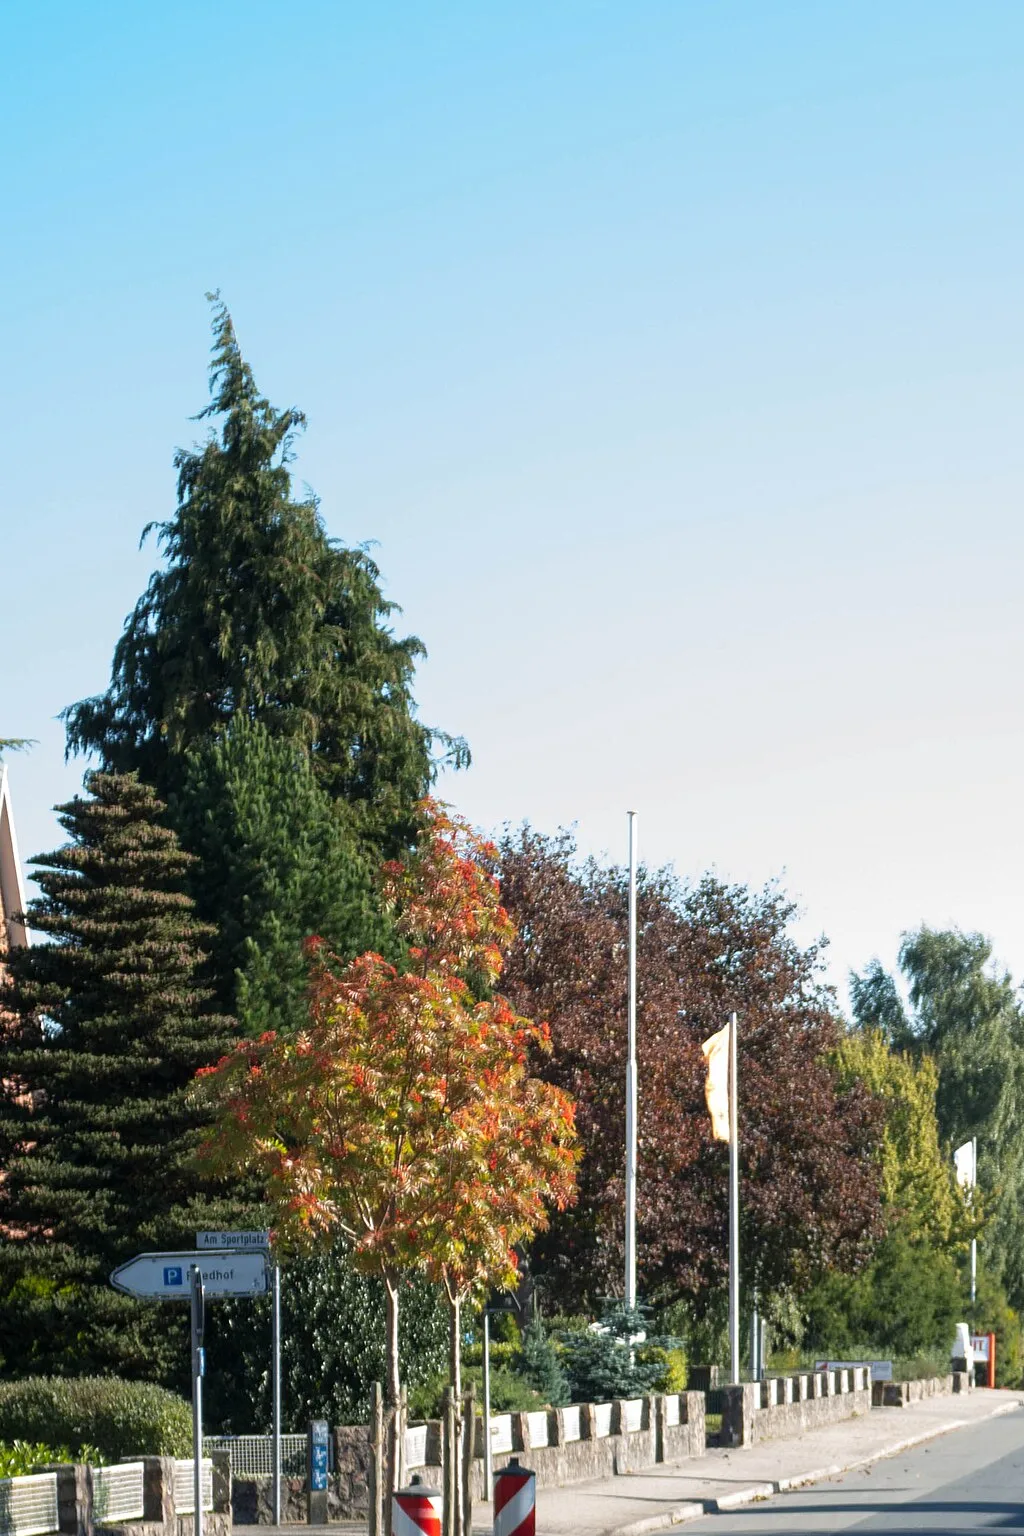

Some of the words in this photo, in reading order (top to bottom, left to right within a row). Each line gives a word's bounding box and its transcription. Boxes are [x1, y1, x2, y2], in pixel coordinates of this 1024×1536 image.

[204, 1235, 217, 1244] Am
[221, 1234, 264, 1246] Sportplatz
[186, 1270, 234, 1281] Fedhof
